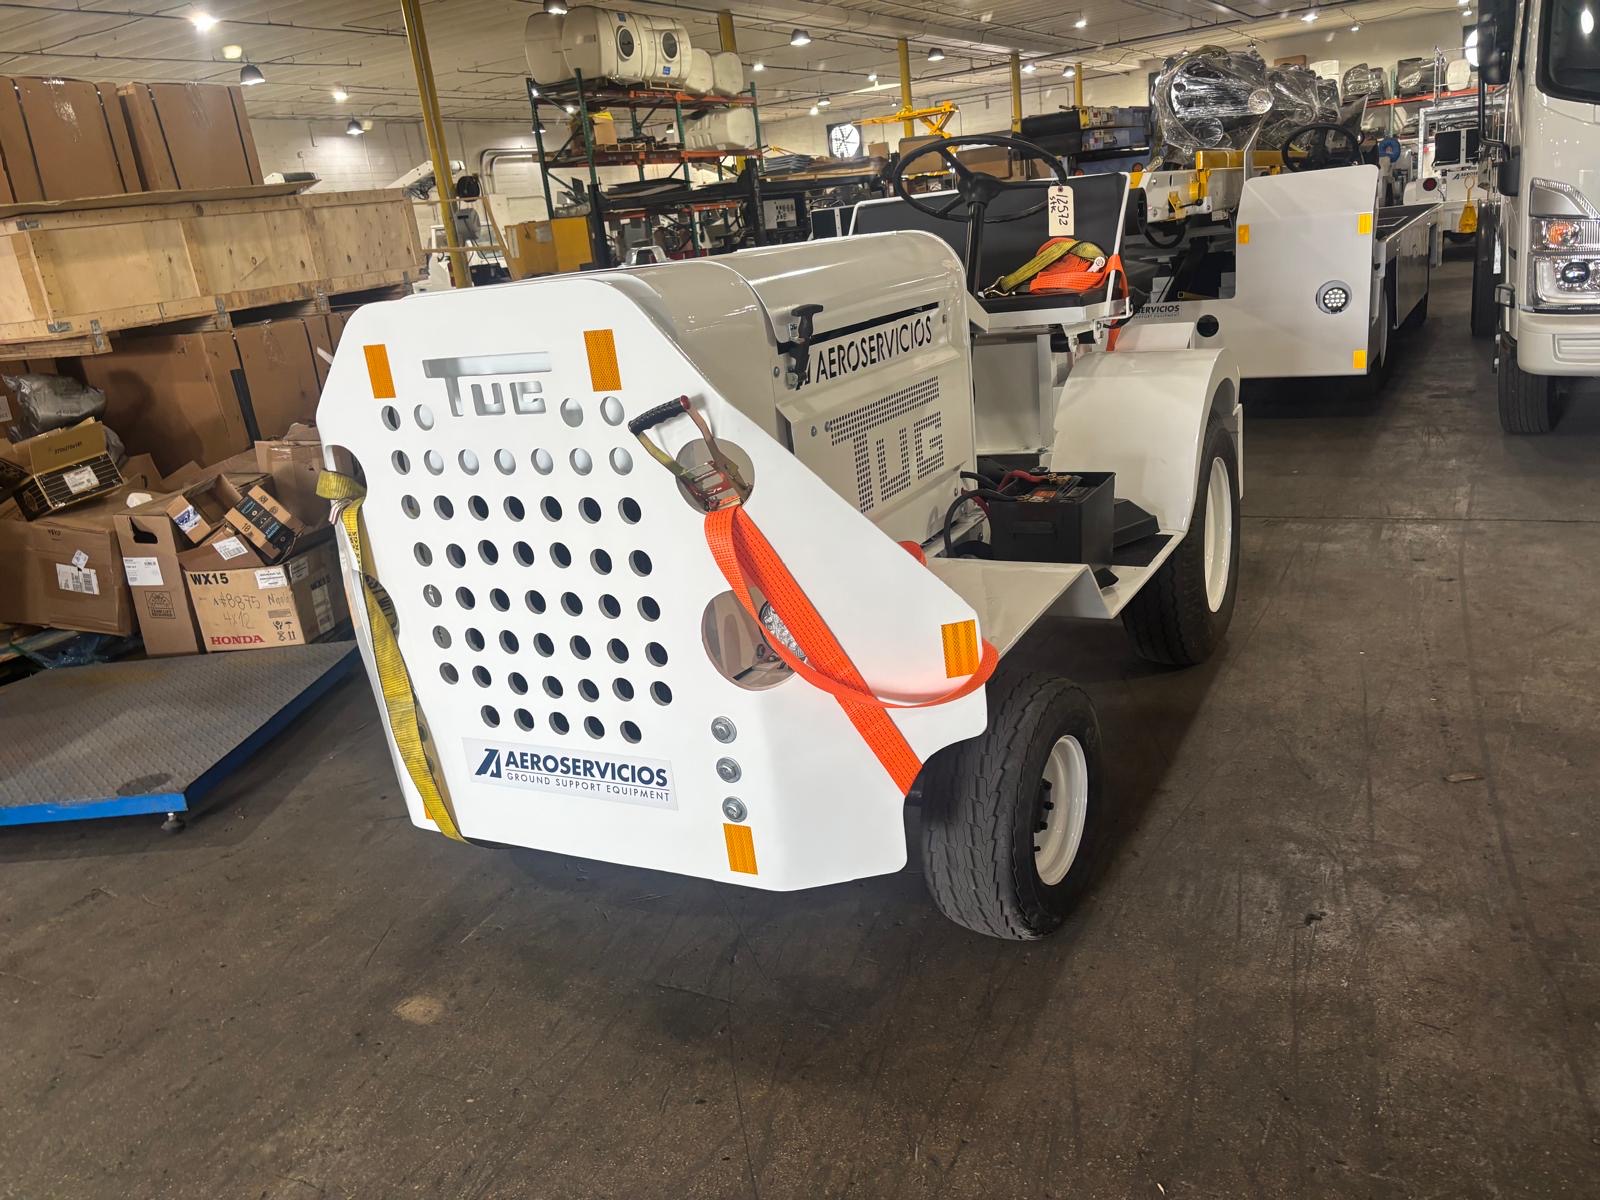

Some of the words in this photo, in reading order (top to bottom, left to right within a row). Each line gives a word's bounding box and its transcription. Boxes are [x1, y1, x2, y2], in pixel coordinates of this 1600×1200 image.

[1056, 194, 1069, 226] 12572
[815, 316, 932, 384] AEROSERVICIOS
[830, 375, 945, 514] TUG
[190, 572, 229, 586] WX15
[210, 635, 265, 646] HONDA
[505, 750, 668, 788] AEROSERVICIOS
[507, 772, 551, 786] GROUND
[555, 778, 602, 792] SUPPORT
[606, 784, 670, 802] EQUIPMENT
